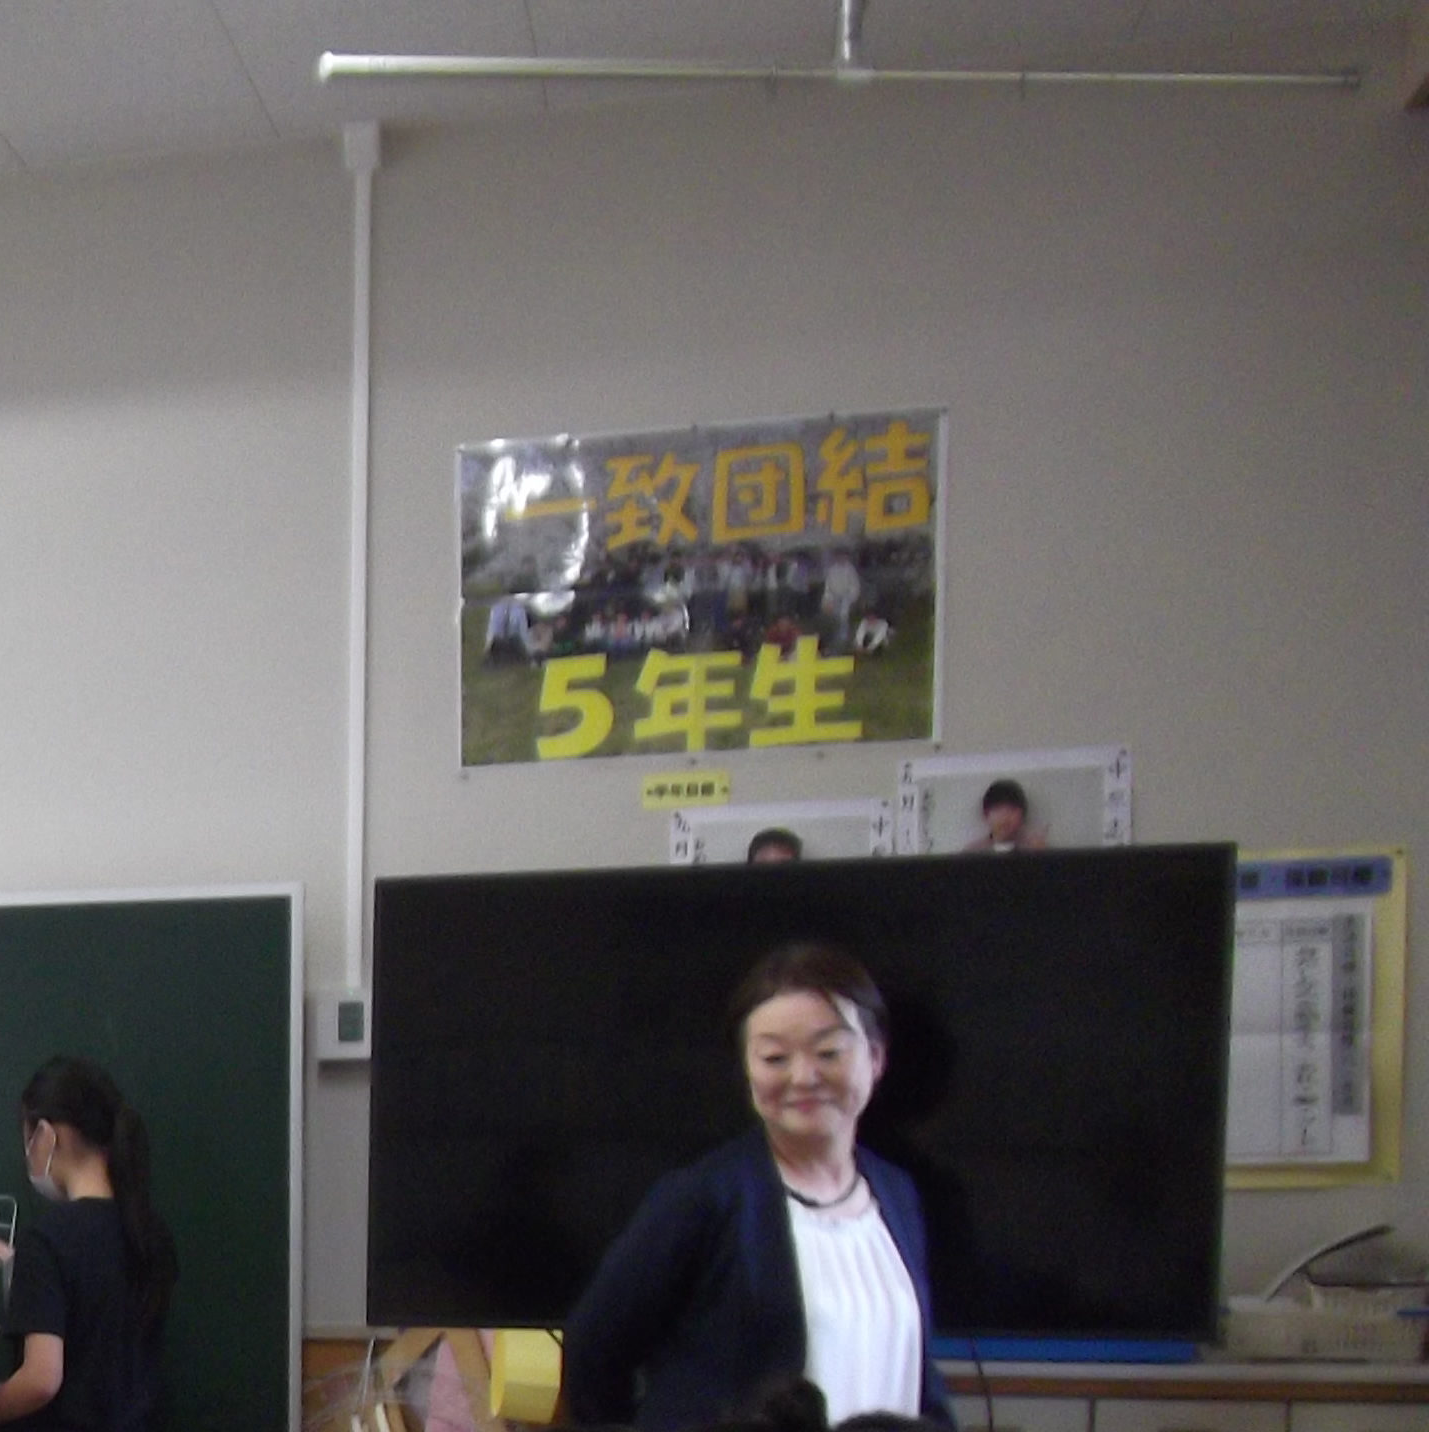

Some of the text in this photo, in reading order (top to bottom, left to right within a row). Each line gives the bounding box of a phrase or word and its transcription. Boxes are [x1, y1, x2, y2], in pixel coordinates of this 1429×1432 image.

[504, 420, 932, 551] 一致団結
[536, 635, 863, 760] 5年生
